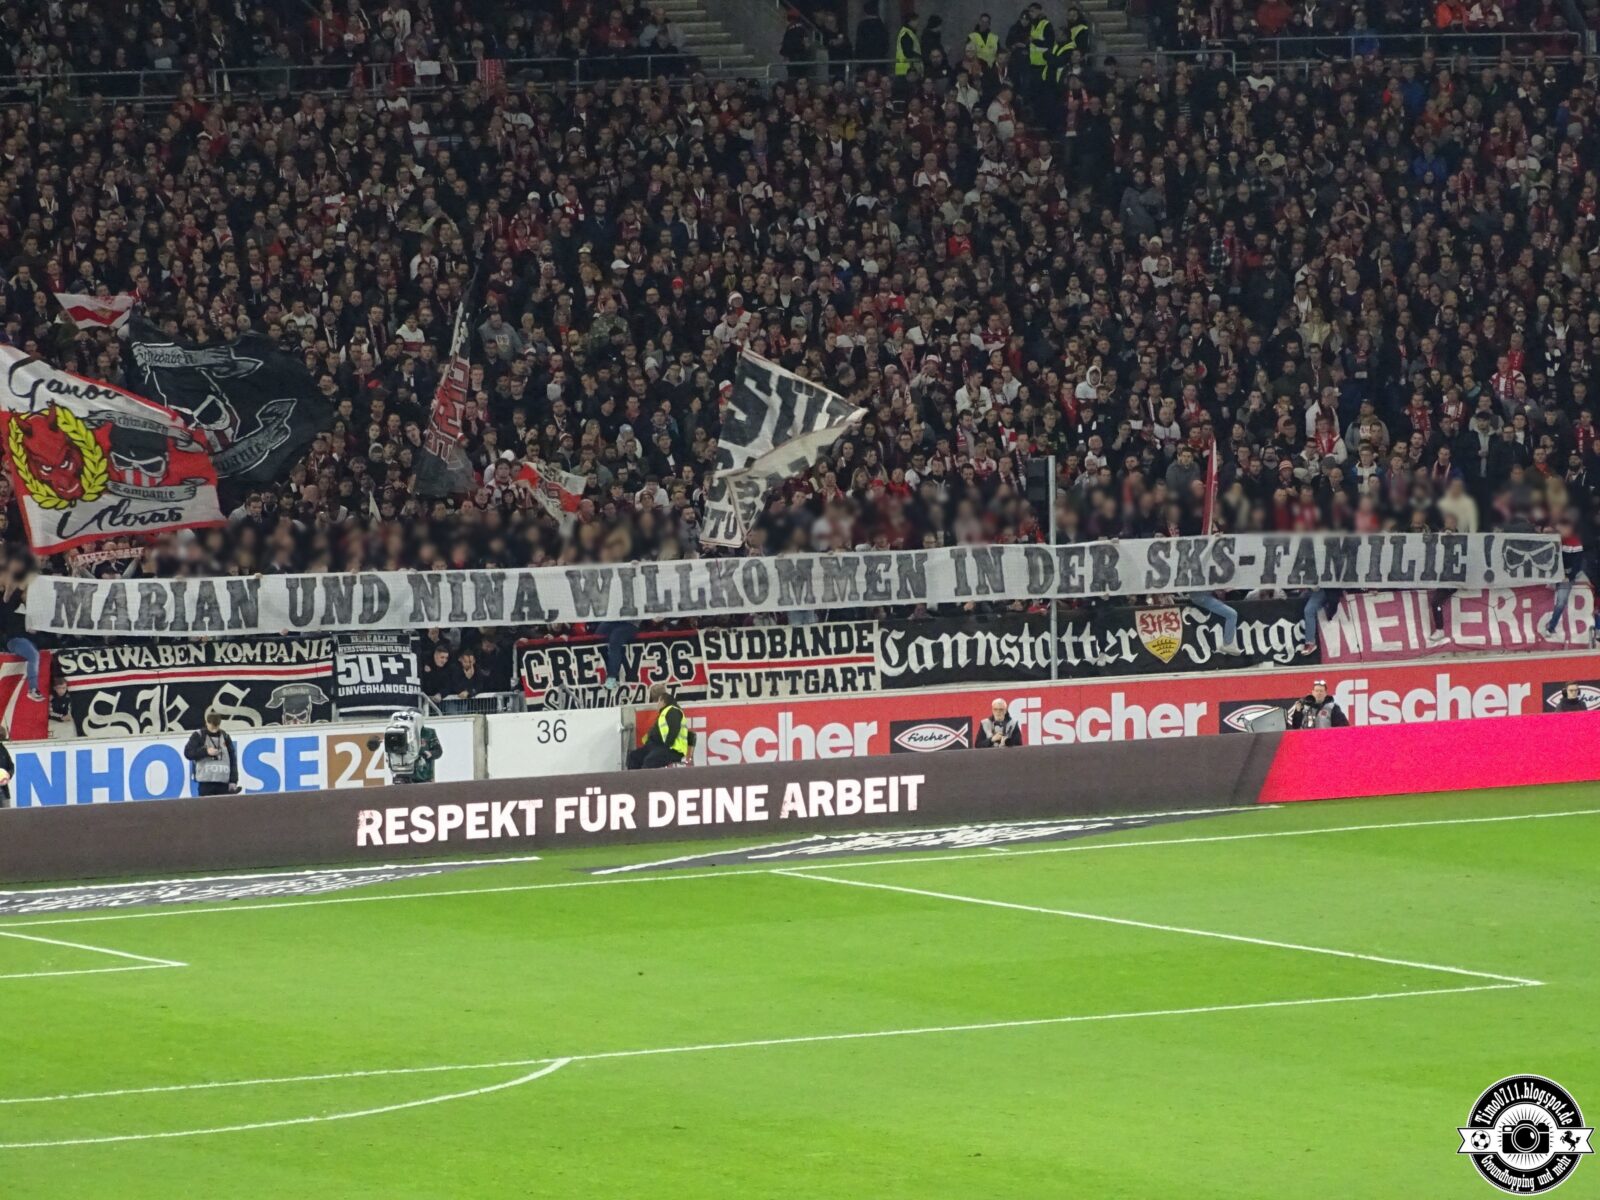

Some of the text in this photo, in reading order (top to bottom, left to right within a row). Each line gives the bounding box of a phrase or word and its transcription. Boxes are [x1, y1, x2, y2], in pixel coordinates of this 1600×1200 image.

[51, 578, 261, 631] MARIAN
[286, 574, 391, 627] UND
[408, 571, 559, 624] NINA,
[565, 551, 928, 618] WILLKOMMEN
[950, 545, 1006, 597] IN
[1026, 540, 1122, 595] DER
[57, 637, 334, 675] SCHWABEN KOMPANIE
[703, 622, 874, 661] SÜDBANDE
[880, 621, 1139, 677] Cannstatter
[336, 653, 421, 686] 50+1
[709, 665, 876, 699] STUTTGART
[536, 719, 567, 744] 36
[686, 711, 878, 767] ischer
[906, 731, 951, 743] fischer
[356, 774, 926, 847] RESPEKT FÜR DEINE ARBEIT
